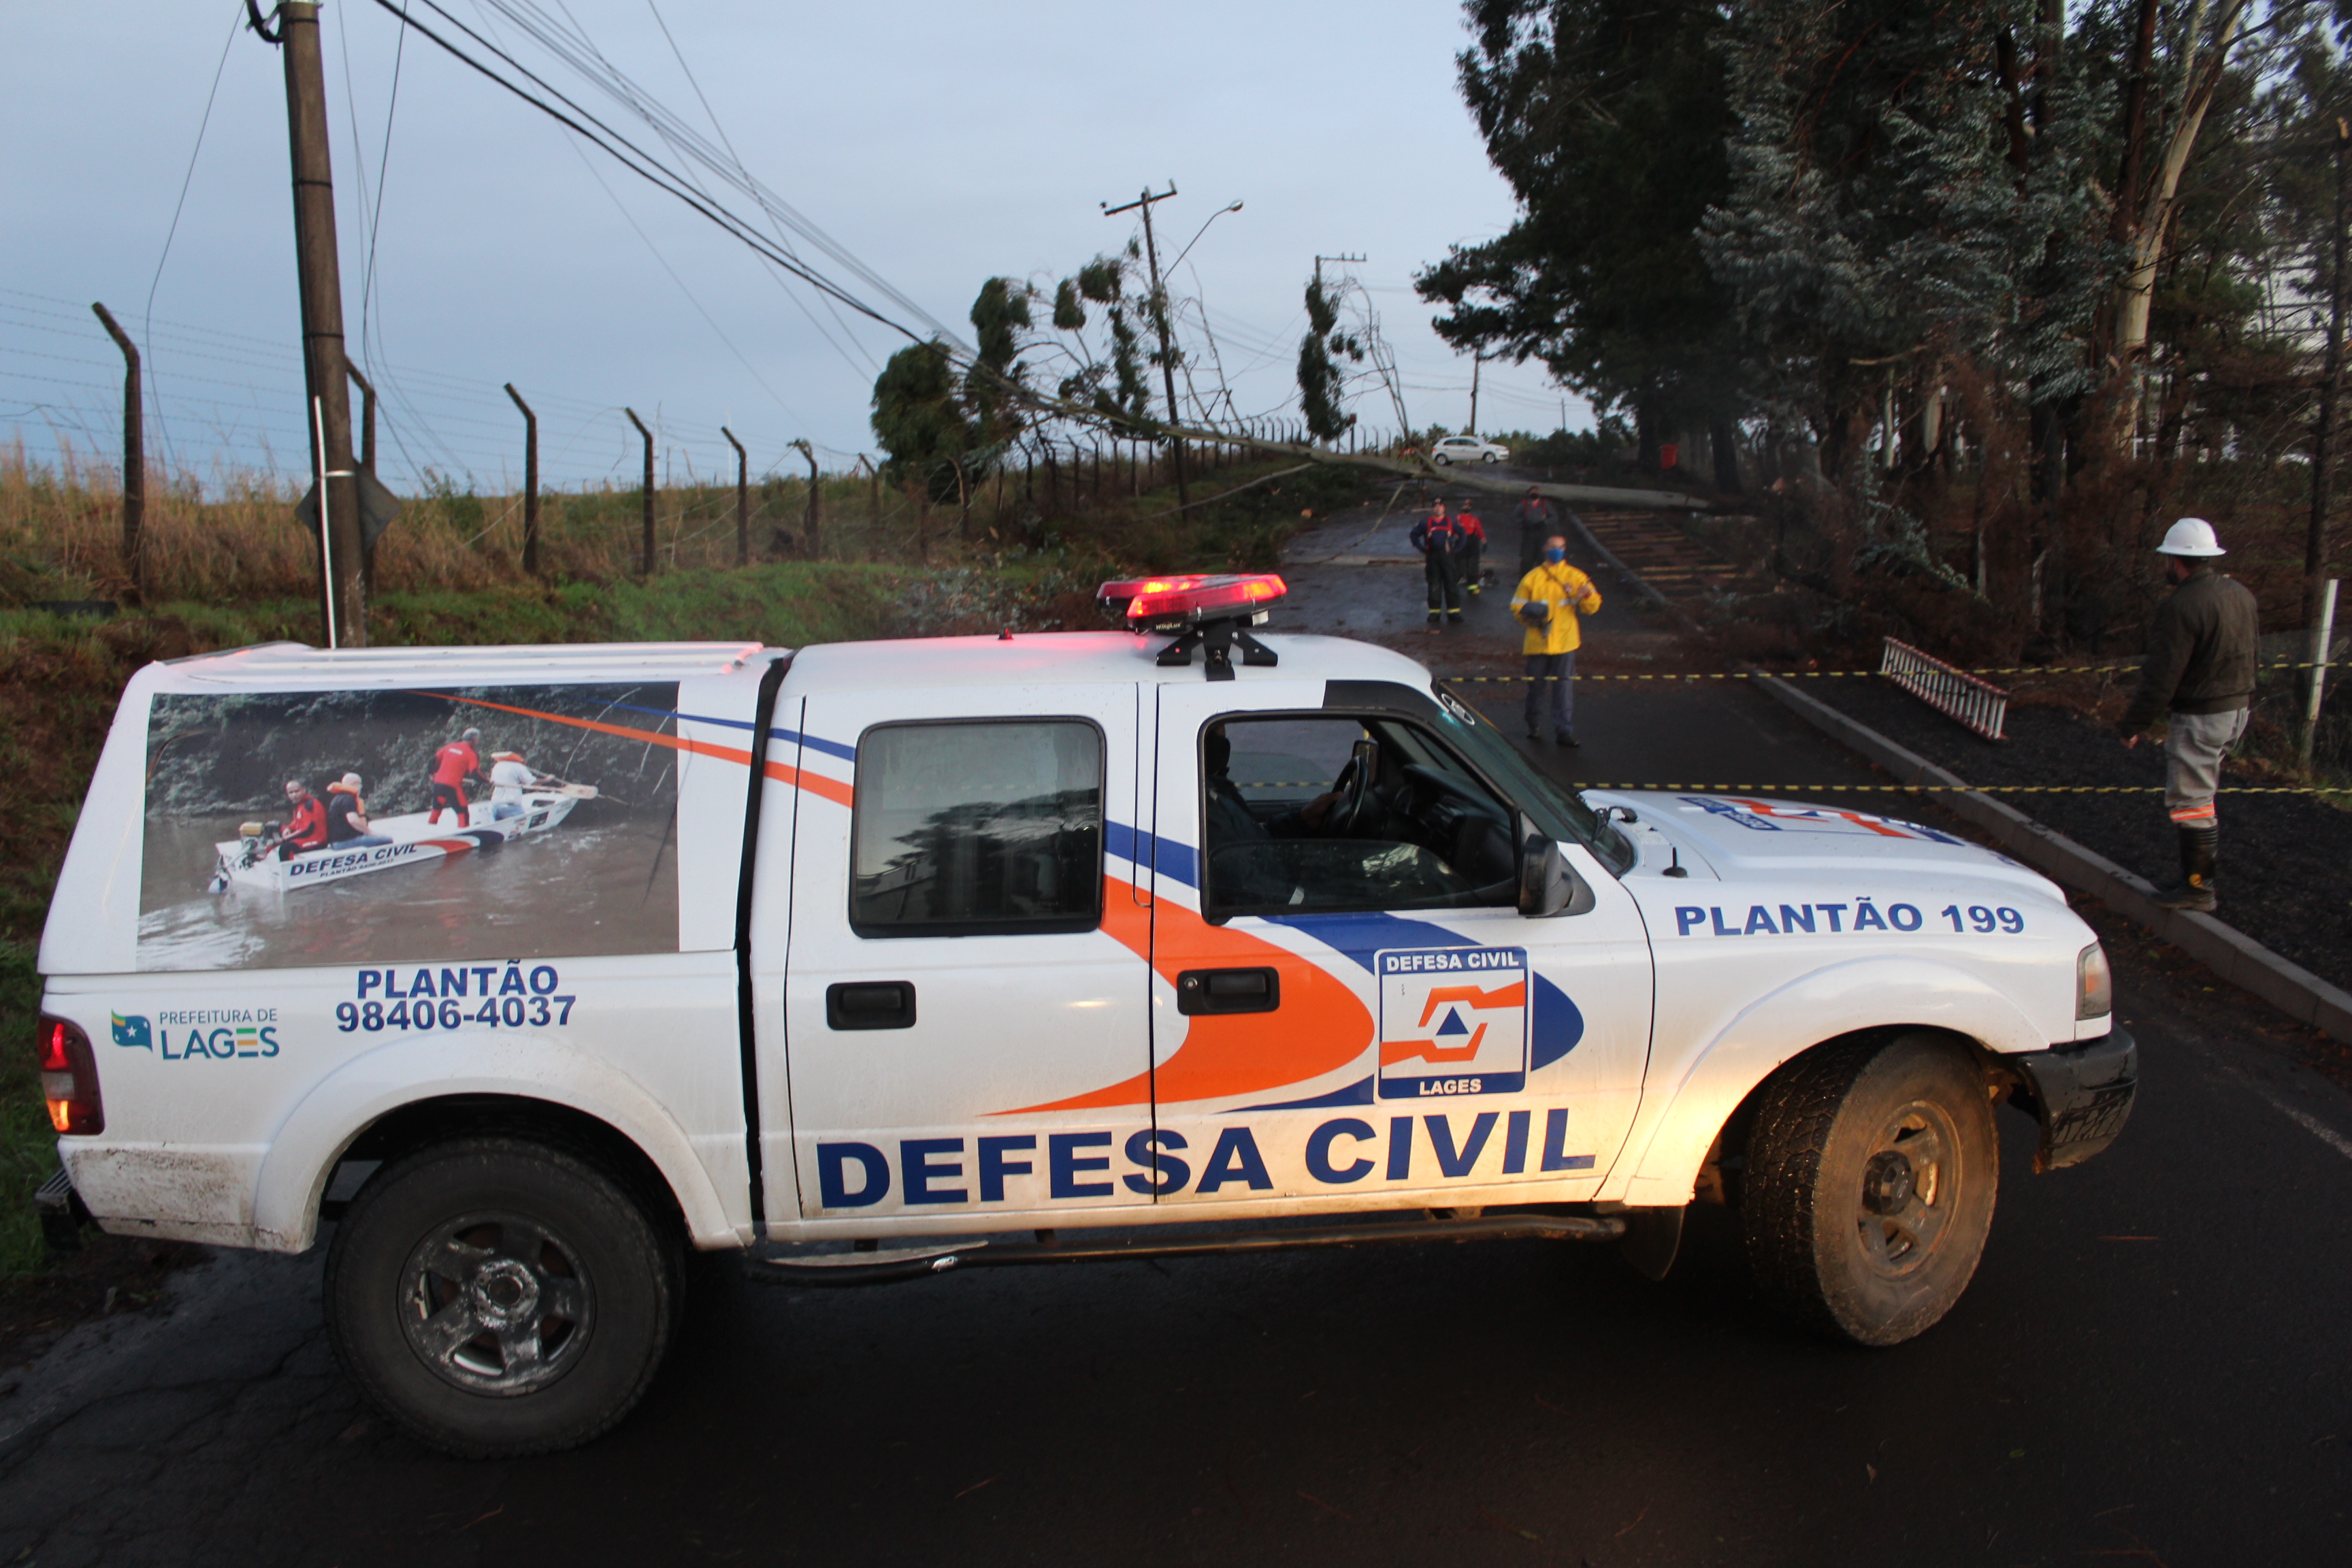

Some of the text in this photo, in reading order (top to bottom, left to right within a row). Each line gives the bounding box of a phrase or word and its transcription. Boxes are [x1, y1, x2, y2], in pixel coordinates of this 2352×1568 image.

[290, 844, 416, 877] DEFESA CIVIL
[1675, 896, 2025, 936] PLANTÃO 199
[1386, 951, 1520, 972] DEFESA CIVIL
[357, 960, 557, 999] PLANTÃO
[159, 1007, 277, 1025] PREFEITURA DE
[336, 996, 576, 1032] 98406-4037
[159, 1026, 280, 1061] LAGES
[1419, 1078, 1482, 1096] LAGES
[817, 1109, 1596, 1209] DEFESA CIVIL
